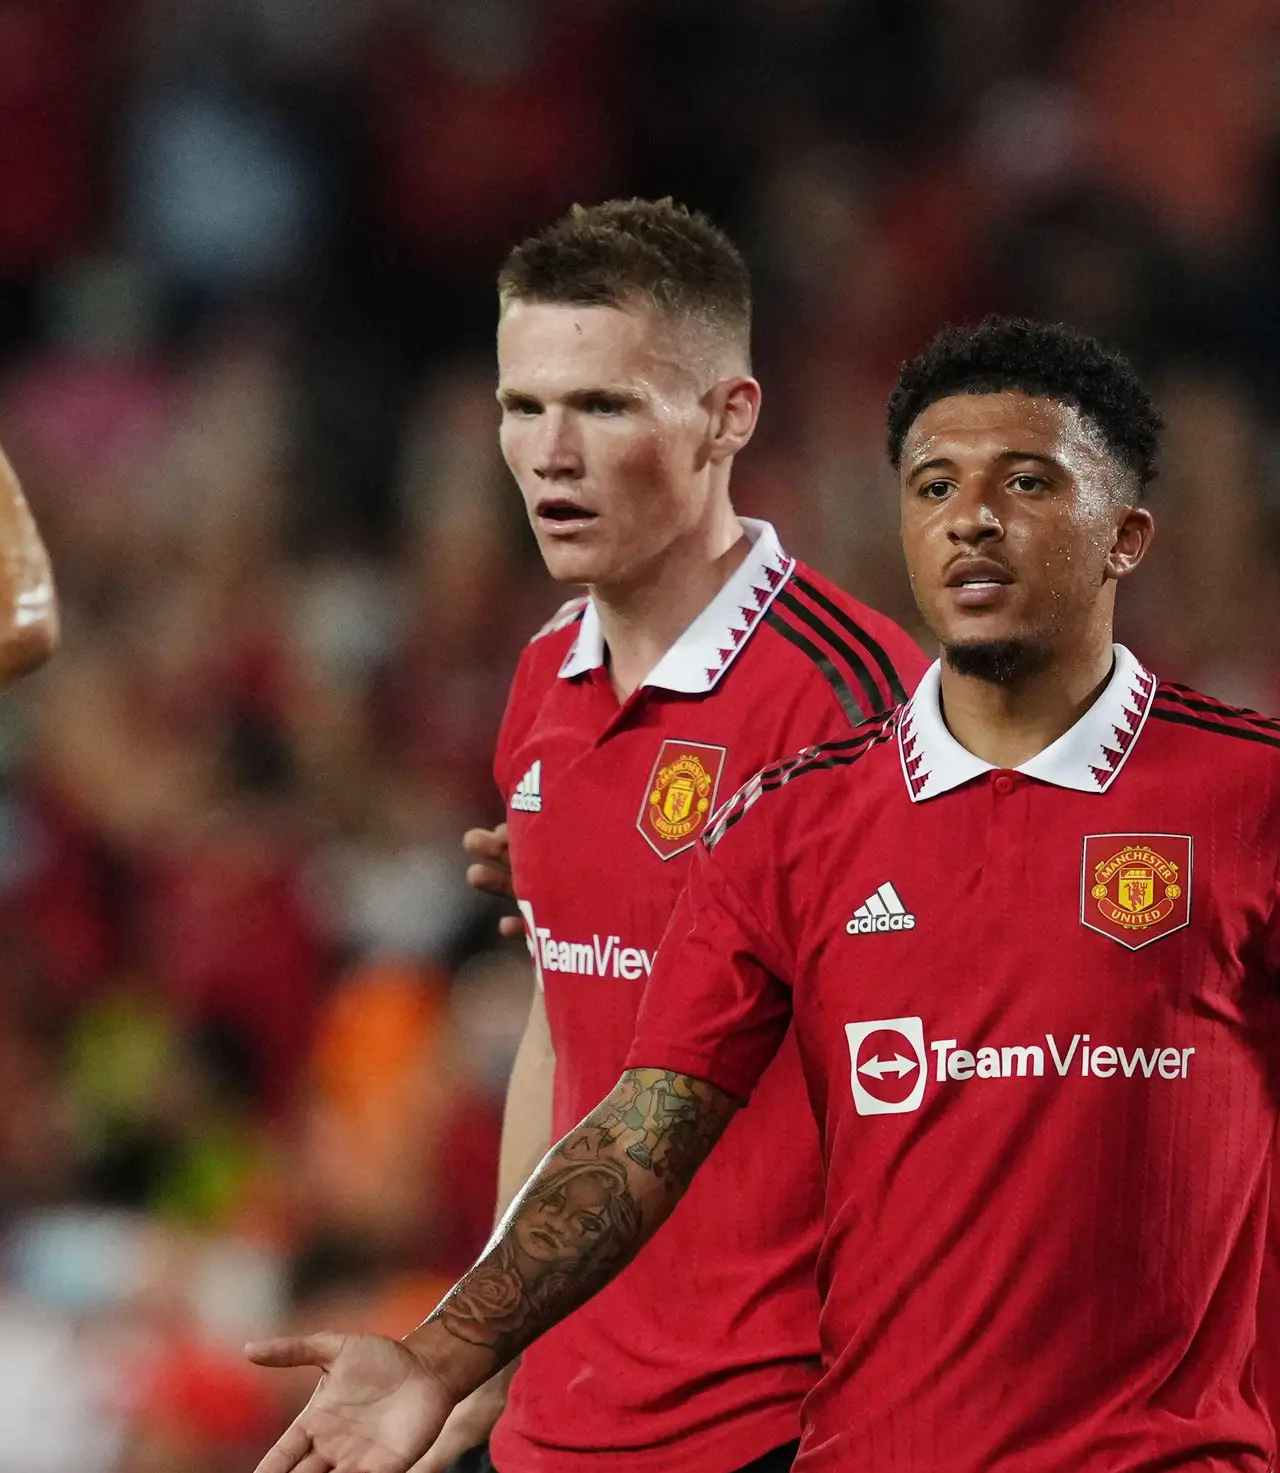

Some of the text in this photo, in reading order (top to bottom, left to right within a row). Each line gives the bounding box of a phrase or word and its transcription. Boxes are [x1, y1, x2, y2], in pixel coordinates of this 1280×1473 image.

[1102, 853, 1172, 879] MANCHESTER
[846, 914, 915, 935] adidas
[1111, 910, 1161, 924] UNITED
[931, 1034, 1195, 1082] TeamViewer
